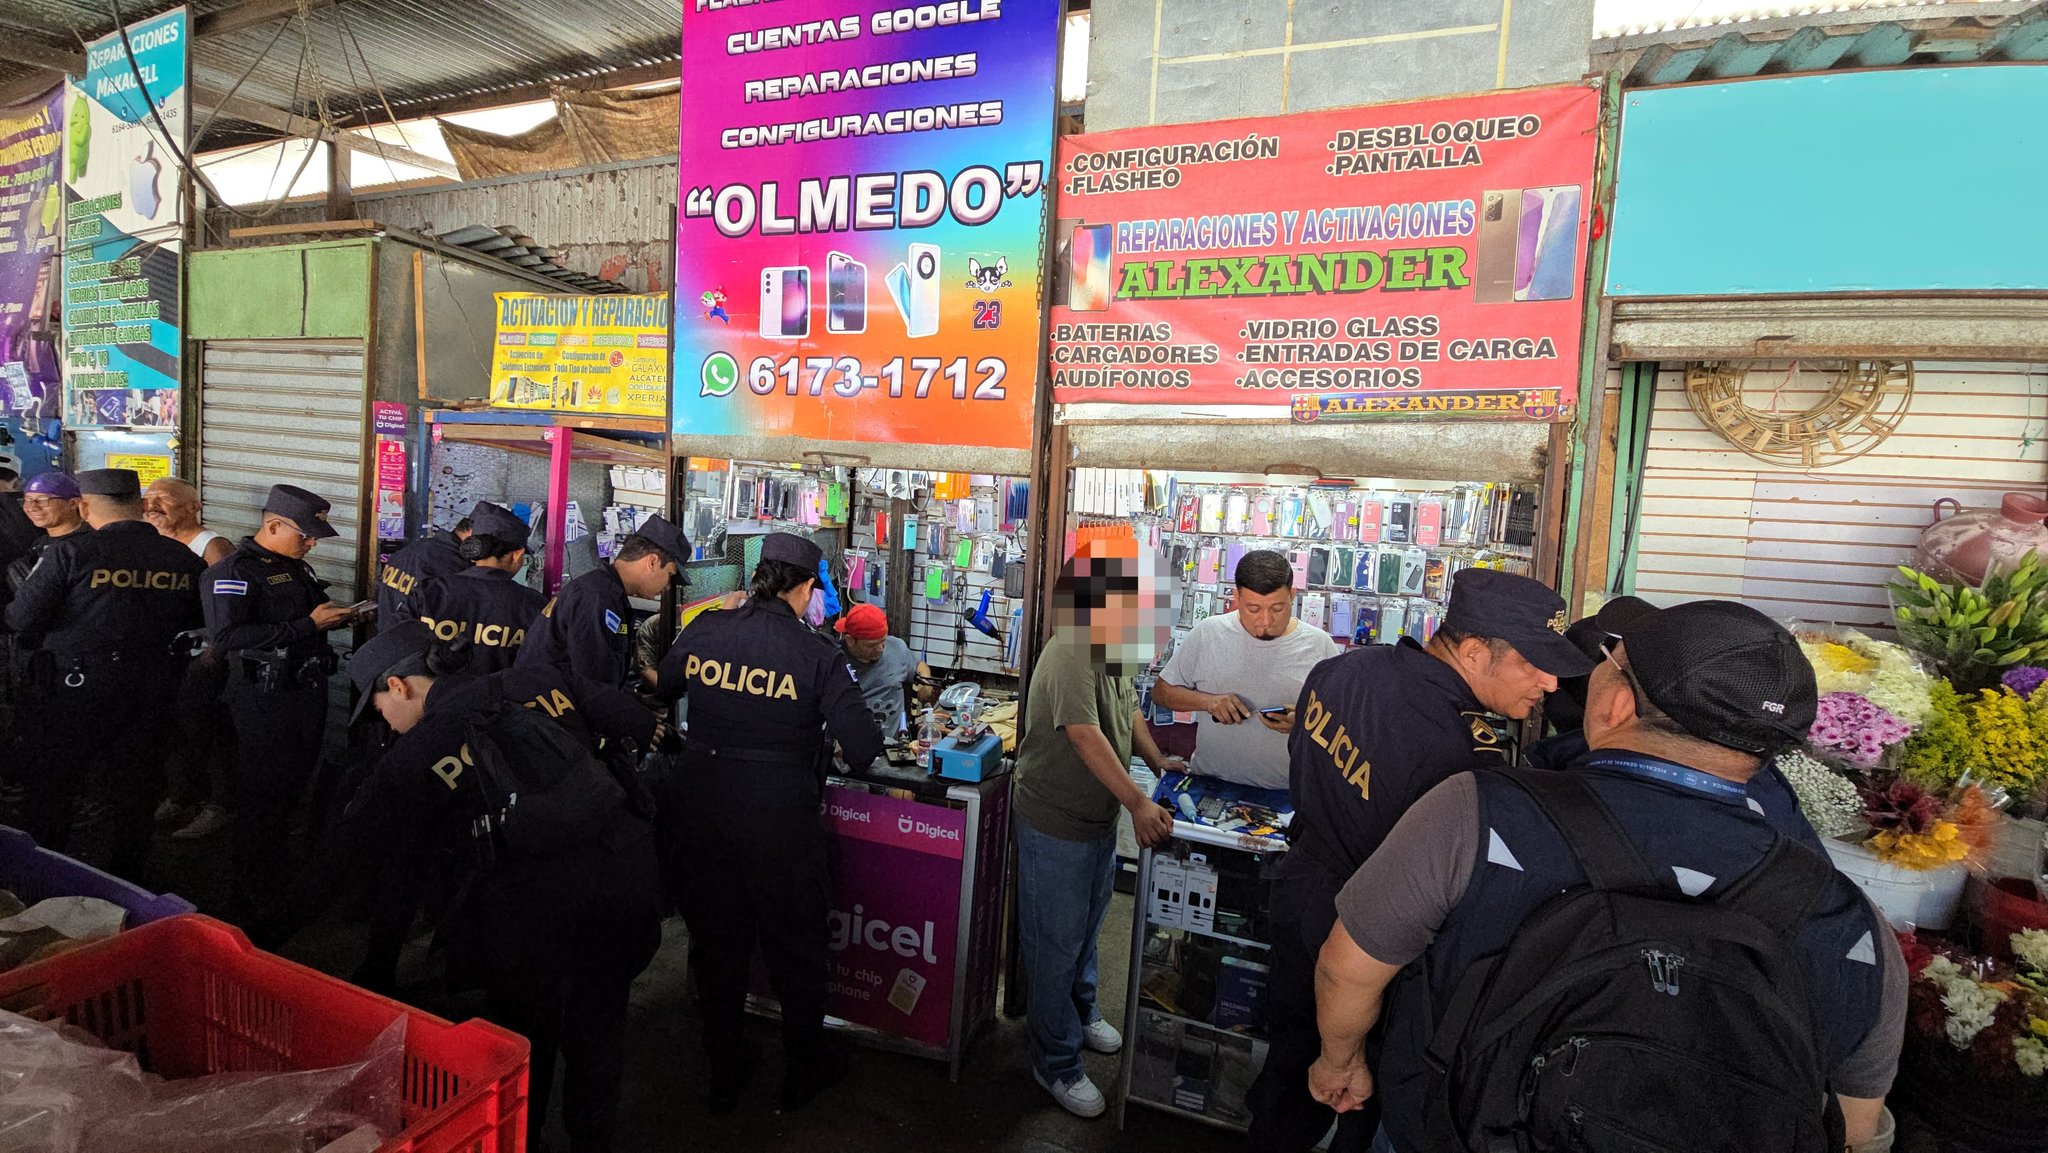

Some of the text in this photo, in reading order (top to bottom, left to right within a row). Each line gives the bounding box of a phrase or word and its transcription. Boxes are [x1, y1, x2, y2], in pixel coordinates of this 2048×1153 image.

[727, 0, 1001, 55] CUENTAS GOOGLE
[88, 21, 179, 72] REPARCIONES
[96, 64, 159, 100] MAKACELL
[744, 52, 978, 103] REPARACIONES
[720, 100, 1003, 149] CONFIGURACIONES
[1336, 113, 1542, 154] DESBLOQUEO
[1073, 132, 1279, 174] CONFIGURACIÓN
[1334, 143, 1482, 176] PANTALLA
[1072, 167, 1181, 196] FLASHEO
[68, 193, 122, 221] LIBERACIONES
[68, 218, 102, 241] FLASHEO
[1116, 199, 1476, 254] REPARACIONES Y ACTIVACIONES
[1116, 246, 1471, 299] ALEXANDER
[67, 278, 149, 305] VIDRIOS TEMPLADOS
[68, 302, 160, 326] CAMBIO DE PANTALLAS
[501, 297, 578, 327] ACTIVACION
[581, 297, 590, 327] Y
[971, 298, 1003, 331] 23
[68, 324, 152, 348] ENTRADA DE CARGAS
[1056, 322, 1172, 343] BATERIAS
[1247, 316, 1439, 341] VIDRIO GLASS
[70, 351, 88, 367] TIPO
[1054, 344, 1219, 366] CARGADORES
[1243, 336, 1557, 365] ENTRADAS DE CARGA
[75, 372, 105, 388] MUCHO
[629, 374, 667, 383] ALCATEL
[631, 363, 666, 373] GALAXY
[748, 354, 1008, 401] 6173-1712
[1053, 366, 1192, 389] AUDÍFONOS
[1242, 367, 1422, 389] ACCESORIOS
[627, 393, 666, 402] XPERIA
[1324, 394, 1523, 415] ALEXANDER
[90, 568, 191, 590] POLICIA
[381, 563, 417, 596] OLICI
[685, 654, 798, 700] POLICIA
[1762, 701, 1785, 715] FGR
[830, 804, 871, 823] Digicel
[916, 821, 960, 841] Digicel
[827, 904, 937, 965] gicel
[855, 968, 883, 988] chip
